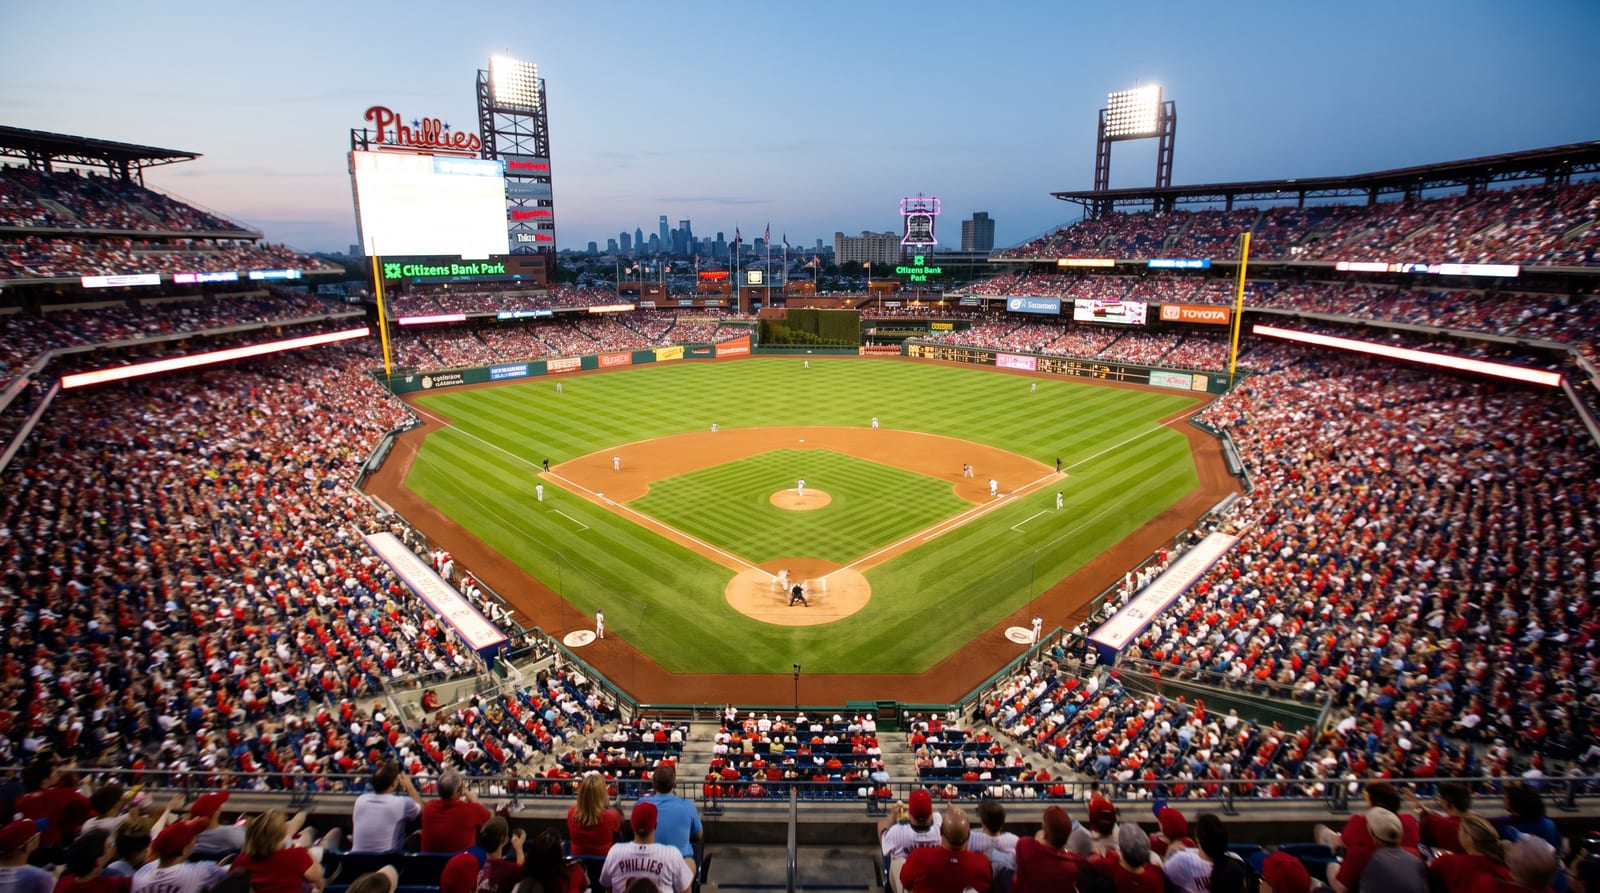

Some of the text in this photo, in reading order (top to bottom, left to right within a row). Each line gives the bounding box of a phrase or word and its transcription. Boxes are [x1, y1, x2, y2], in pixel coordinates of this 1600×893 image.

[365, 105, 482, 151] Phillies
[402, 262, 506, 277] Citizens Bank Park
[896, 266, 942, 274] Citizens Bank
[910, 274, 927, 282] Park
[1182, 309, 1226, 320] TOYOTA
[618, 857, 664, 876] PHILLIES
